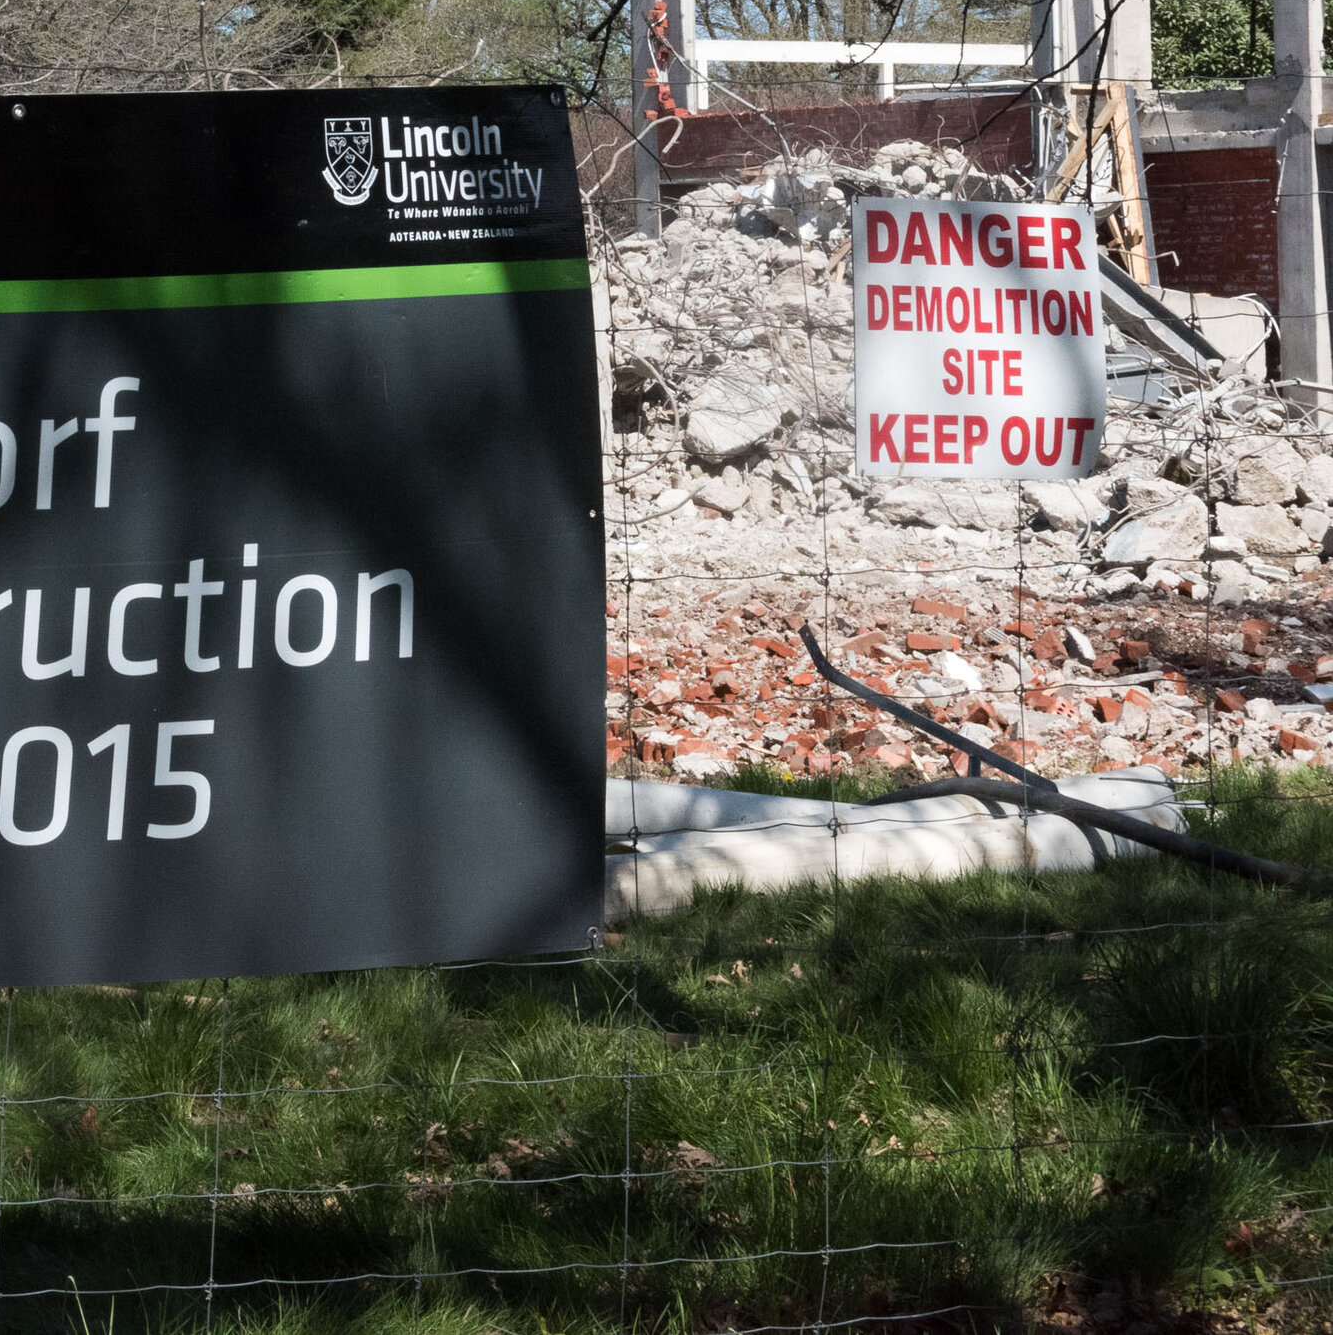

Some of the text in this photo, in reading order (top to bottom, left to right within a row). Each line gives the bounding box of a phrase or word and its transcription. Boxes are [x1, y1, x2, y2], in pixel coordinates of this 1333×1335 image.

[381, 115, 502, 159] Lincoln
[384, 158, 543, 209] University
[388, 208, 400, 219] Te
[404, 207, 438, 219] Whare
[389, 228, 514, 242] AOTEAROA NEW ZEALAND
[868, 210, 1086, 270] DANGER
[867, 285, 1094, 337] DEMOLITION
[942, 348, 1023, 397] SITE
[870, 413, 1095, 466] KEEP OUT
